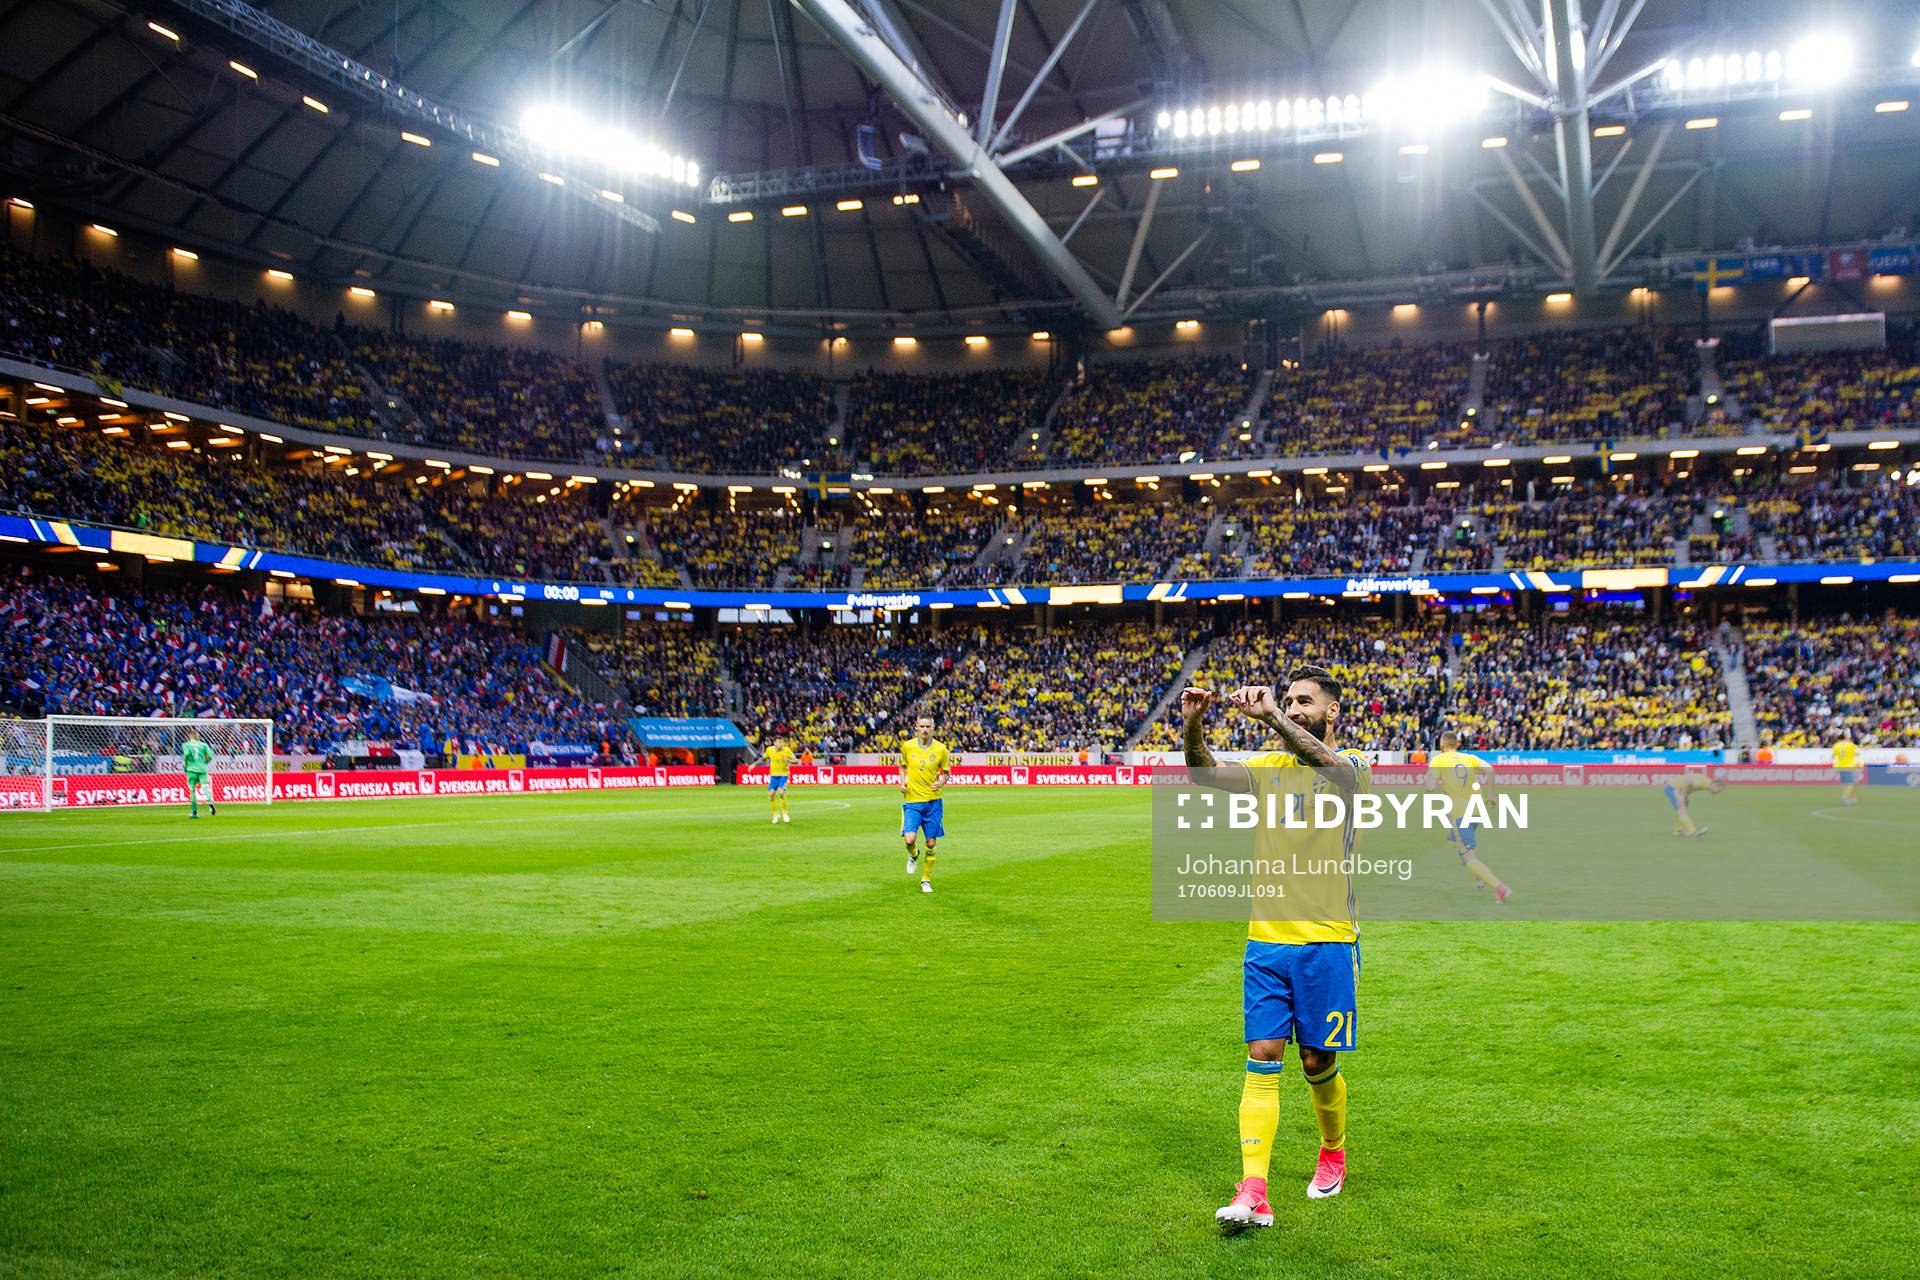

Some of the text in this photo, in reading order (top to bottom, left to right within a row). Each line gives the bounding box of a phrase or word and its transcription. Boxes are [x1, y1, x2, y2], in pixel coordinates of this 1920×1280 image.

[544, 585, 579, 600] 00:00
[603, 775, 655, 788] SVENSKA SPEL
[668, 774, 716, 785] SVENSKA SPEL
[792, 773, 816, 784] SPEL
[837, 773, 883, 785] SVENSKA
[983, 773, 1010, 785] SPEL
[1036, 773, 1114, 785] SVENSKA SPEL
[1138, 773, 1190, 785] SVENSKA
[1454, 763, 1469, 788] 9
[1531, 773, 1563, 785] SPEL
[1588, 773, 1650, 785] SVENSKA
[339, 781, 418, 796] SVENSKA SPEL
[439, 779, 509, 793] SVENSKA SPEL
[529, 777, 589, 790] SVENSKA SPEL
[151, 787, 189, 803] SPEL
[286, 784, 315, 797] SPEL
[0, 791, 39, 806] SPEL
[1324, 1011, 1353, 1047] 21
